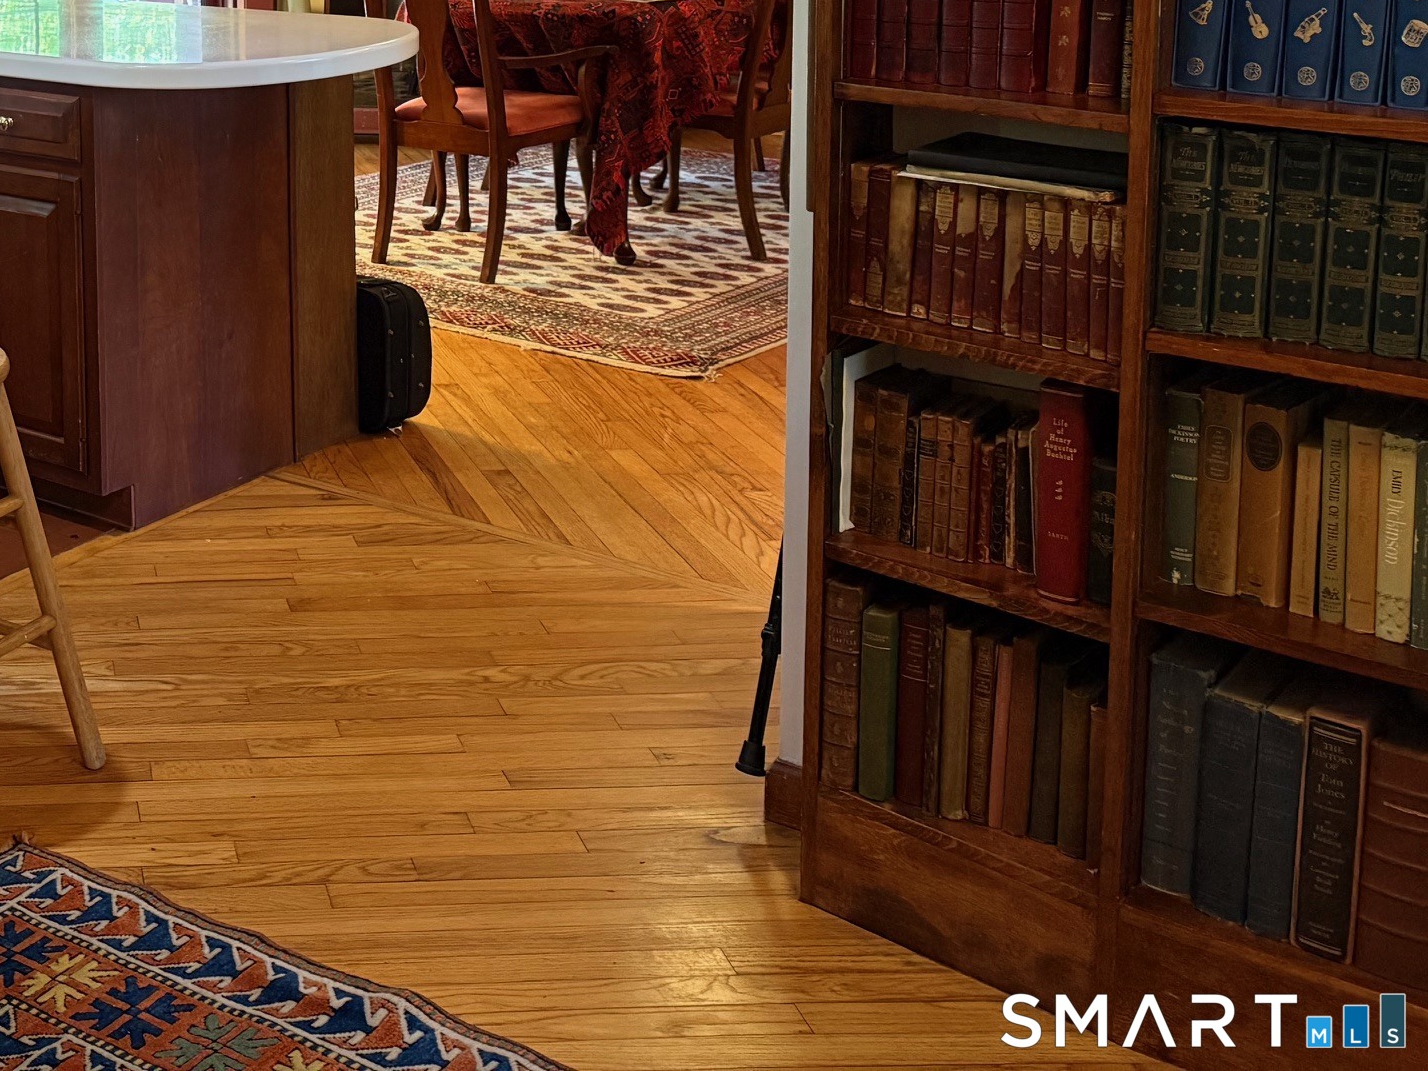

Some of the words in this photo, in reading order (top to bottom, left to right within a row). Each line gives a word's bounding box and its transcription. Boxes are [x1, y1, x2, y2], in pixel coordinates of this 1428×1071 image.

[1049, 433, 1072, 446] Henry
[1328, 460, 1342, 502] CAPSULE
[1391, 470, 1403, 495] EMILY
[1327, 505, 1340, 519] OF
[1327, 520, 1340, 542] THE
[1385, 497, 1406, 566] Dickinson
[1326, 542, 1338, 571] MIND
[1315, 784, 1346, 800] Jones
